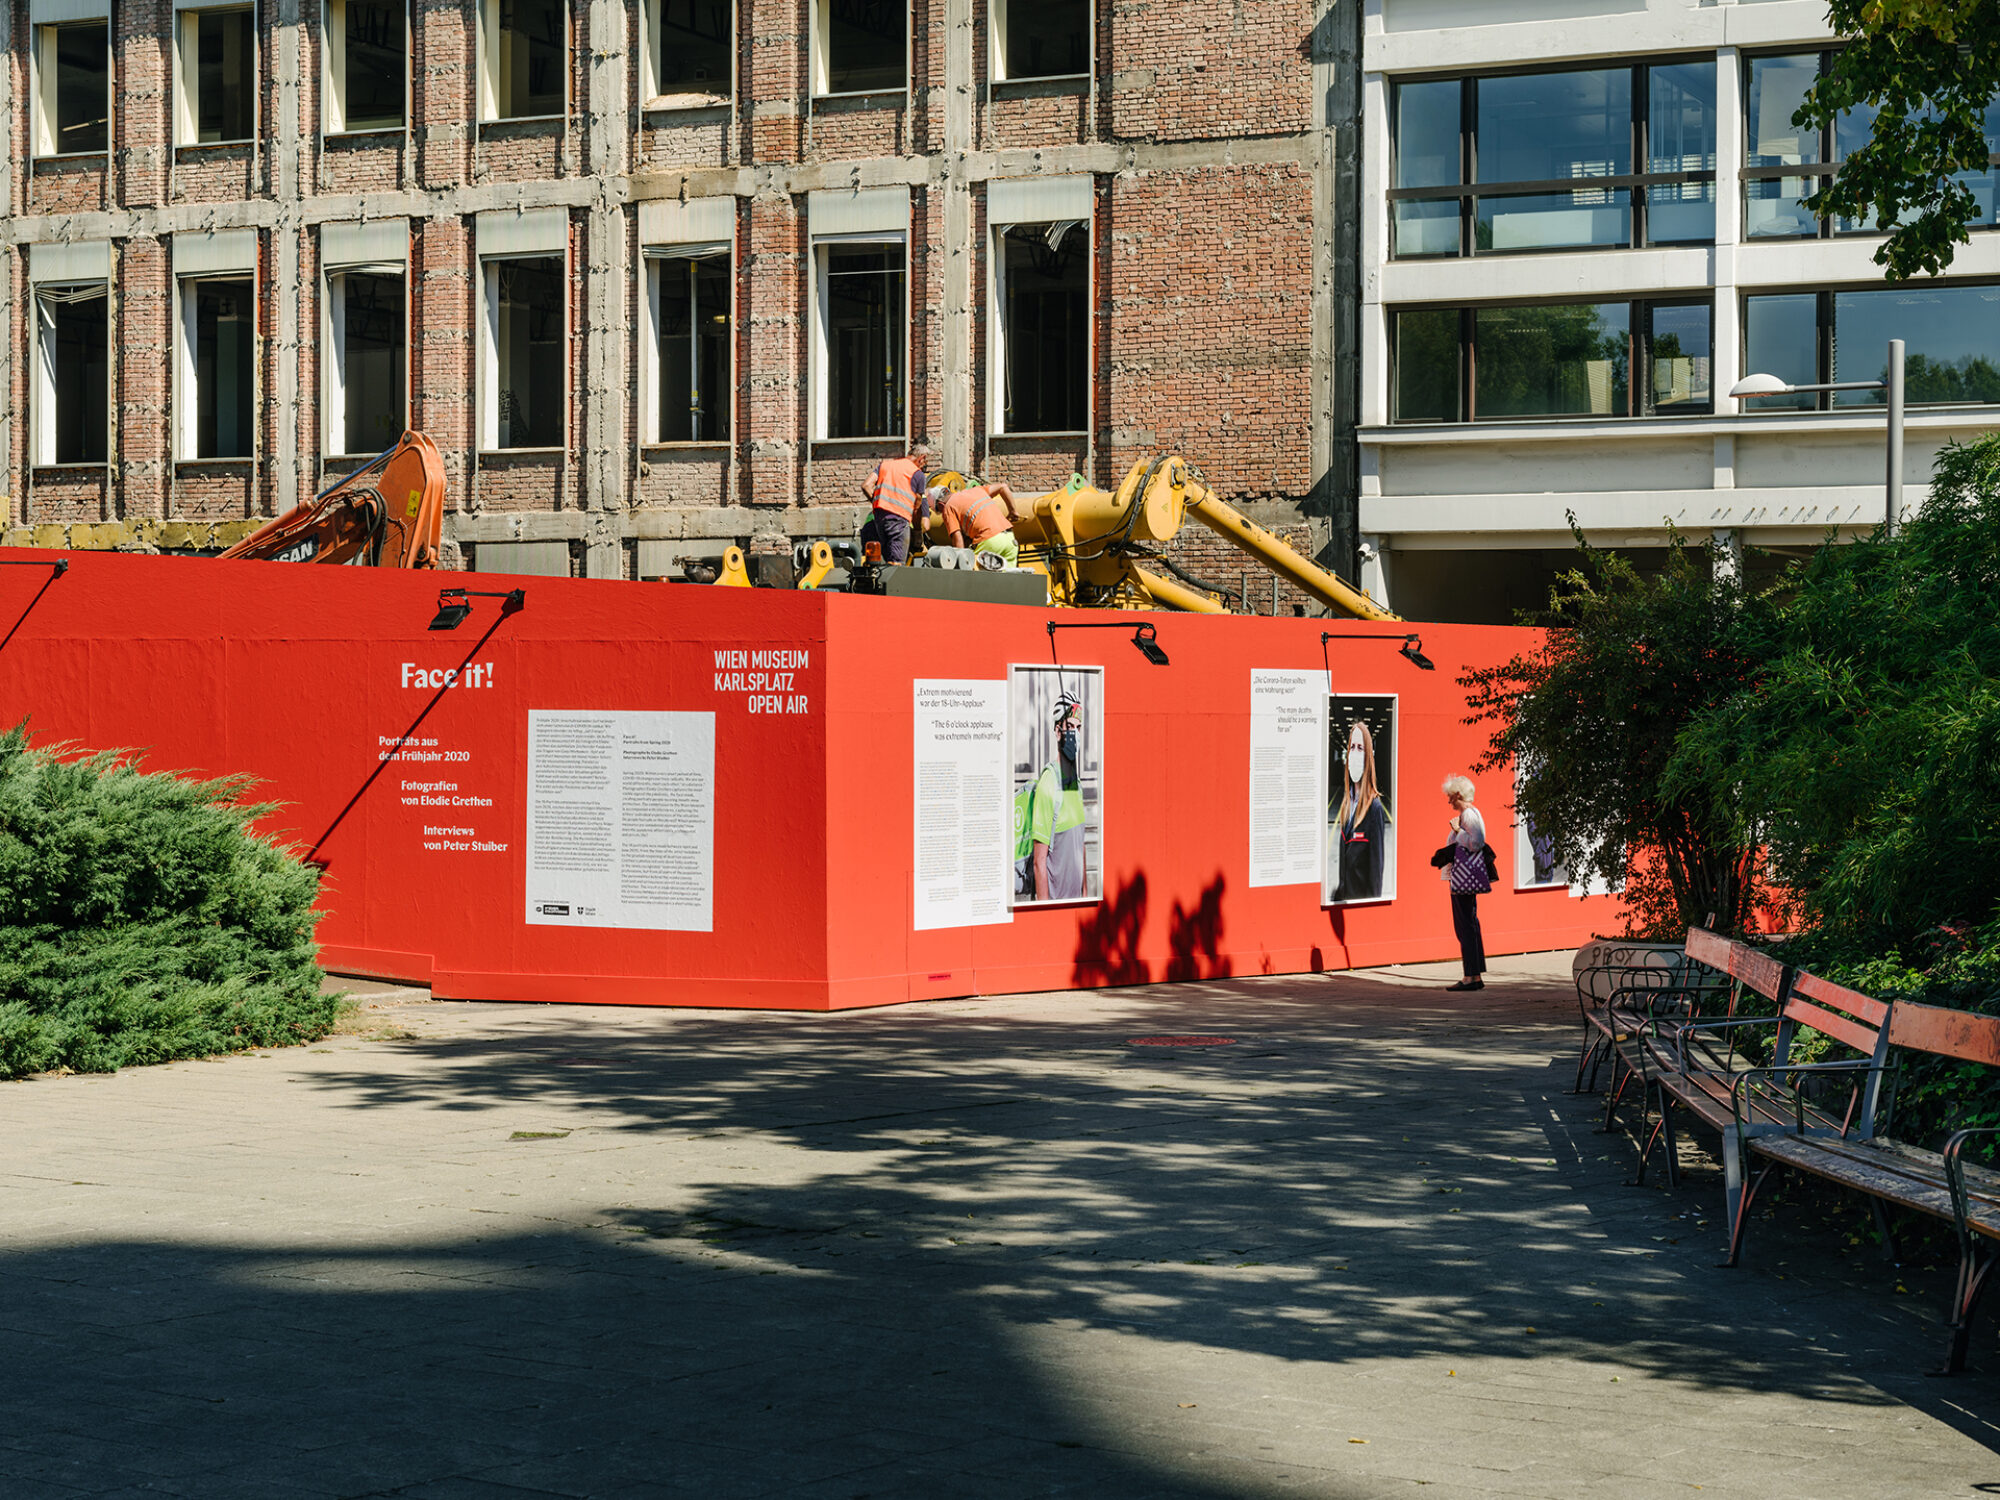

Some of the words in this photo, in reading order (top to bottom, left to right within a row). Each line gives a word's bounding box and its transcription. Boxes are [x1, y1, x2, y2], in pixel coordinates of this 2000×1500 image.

[713, 650, 747, 669] WIEN
[751, 650, 809, 670] MUSEUM
[401, 662, 458, 689] Face
[466, 661, 494, 689] it!
[714, 673, 794, 692] KARLSPLATZ
[941, 688, 973, 697] motivierend
[748, 694, 782, 714] OPEN
[785, 695, 809, 715] AIR
[930, 699, 940, 707] der
[945, 720, 950, 728] 6
[970, 720, 993, 729] applause
[378, 735, 419, 747] Porträts
[421, 737, 438, 747] aus
[946, 732, 972, 741] extremely
[378, 750, 400, 761] dem
[401, 750, 443, 764] Frühjahr
[444, 751, 471, 762] 2020
[401, 780, 458, 793] Fotografien
[401, 796, 419, 806] von
[420, 795, 450, 806] Elodie
[452, 796, 493, 807] Grethen
[424, 825, 475, 837] Interviews
[423, 841, 441, 851] von
[443, 840, 470, 851] Peter
[471, 840, 508, 852] Stuiber
